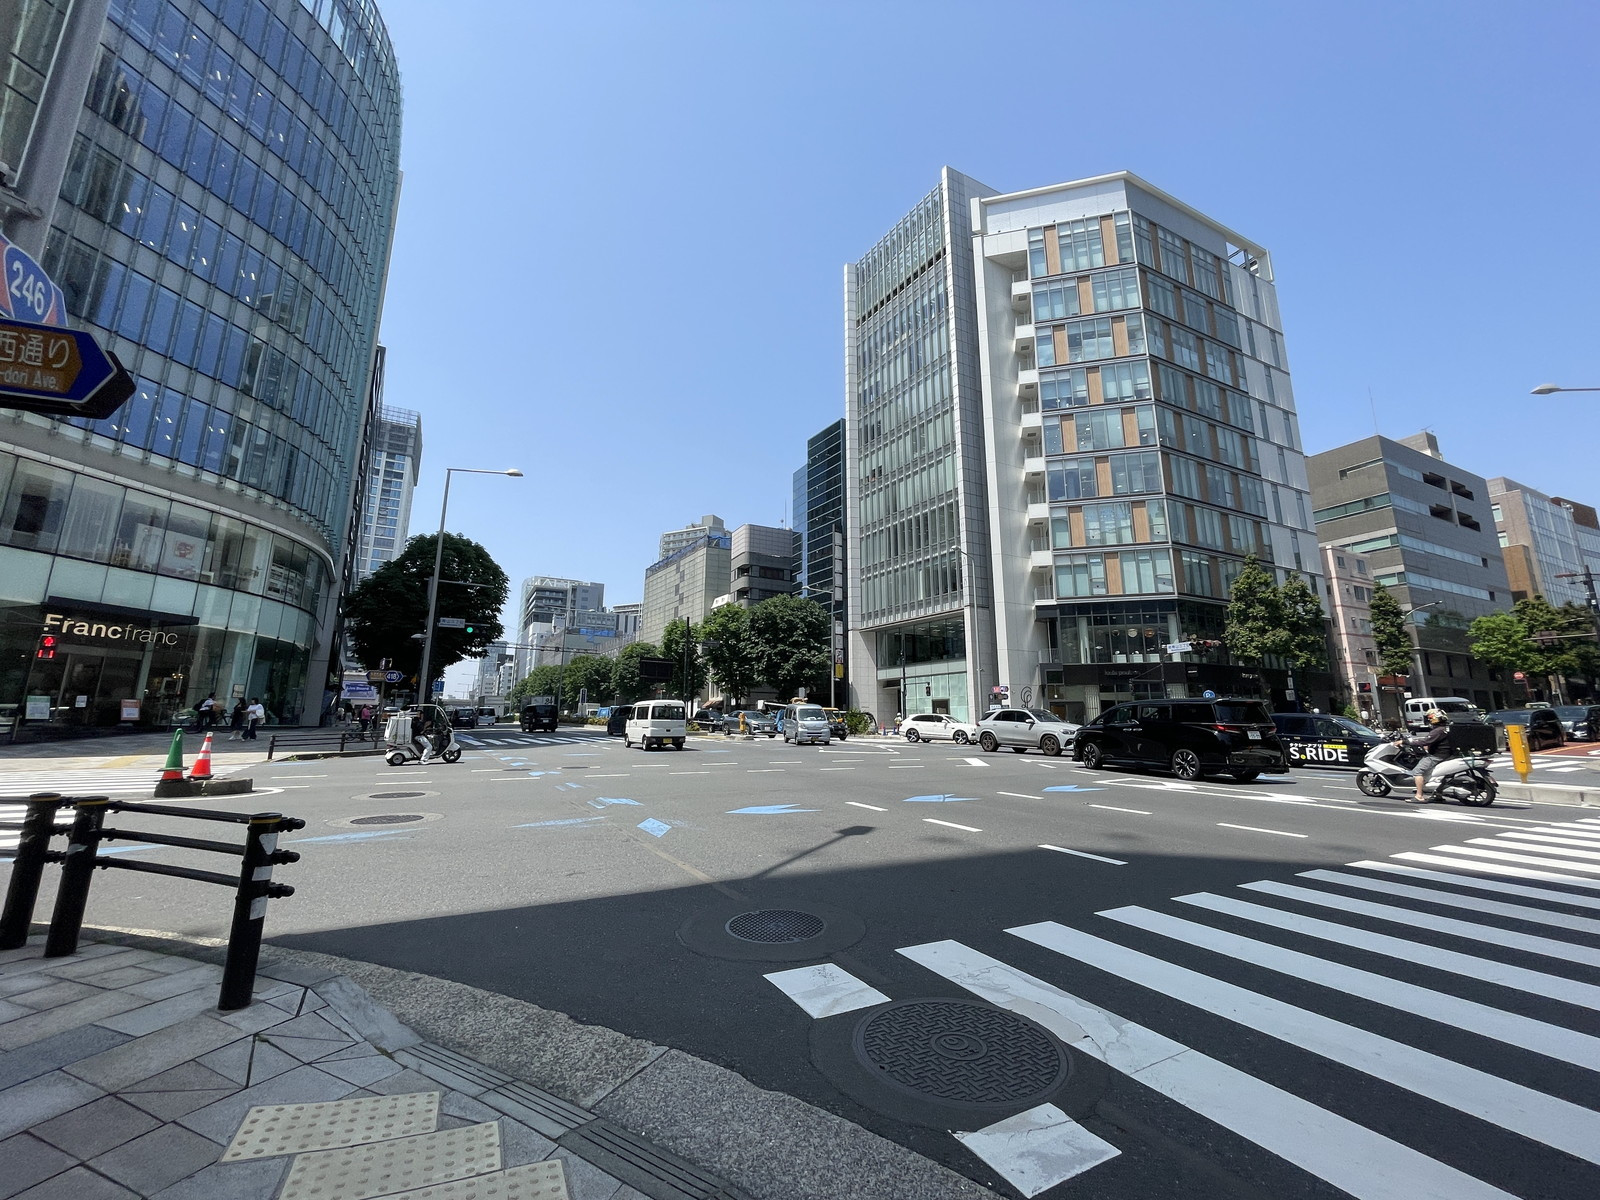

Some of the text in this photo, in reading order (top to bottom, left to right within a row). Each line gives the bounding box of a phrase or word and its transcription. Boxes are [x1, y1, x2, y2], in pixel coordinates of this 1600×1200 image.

[10, 260, 46, 316] 246
[33, 370, 59, 390] Ave.
[44, 613, 178, 646] Francfranc
[1289, 747, 1350, 762] S.RIDE
